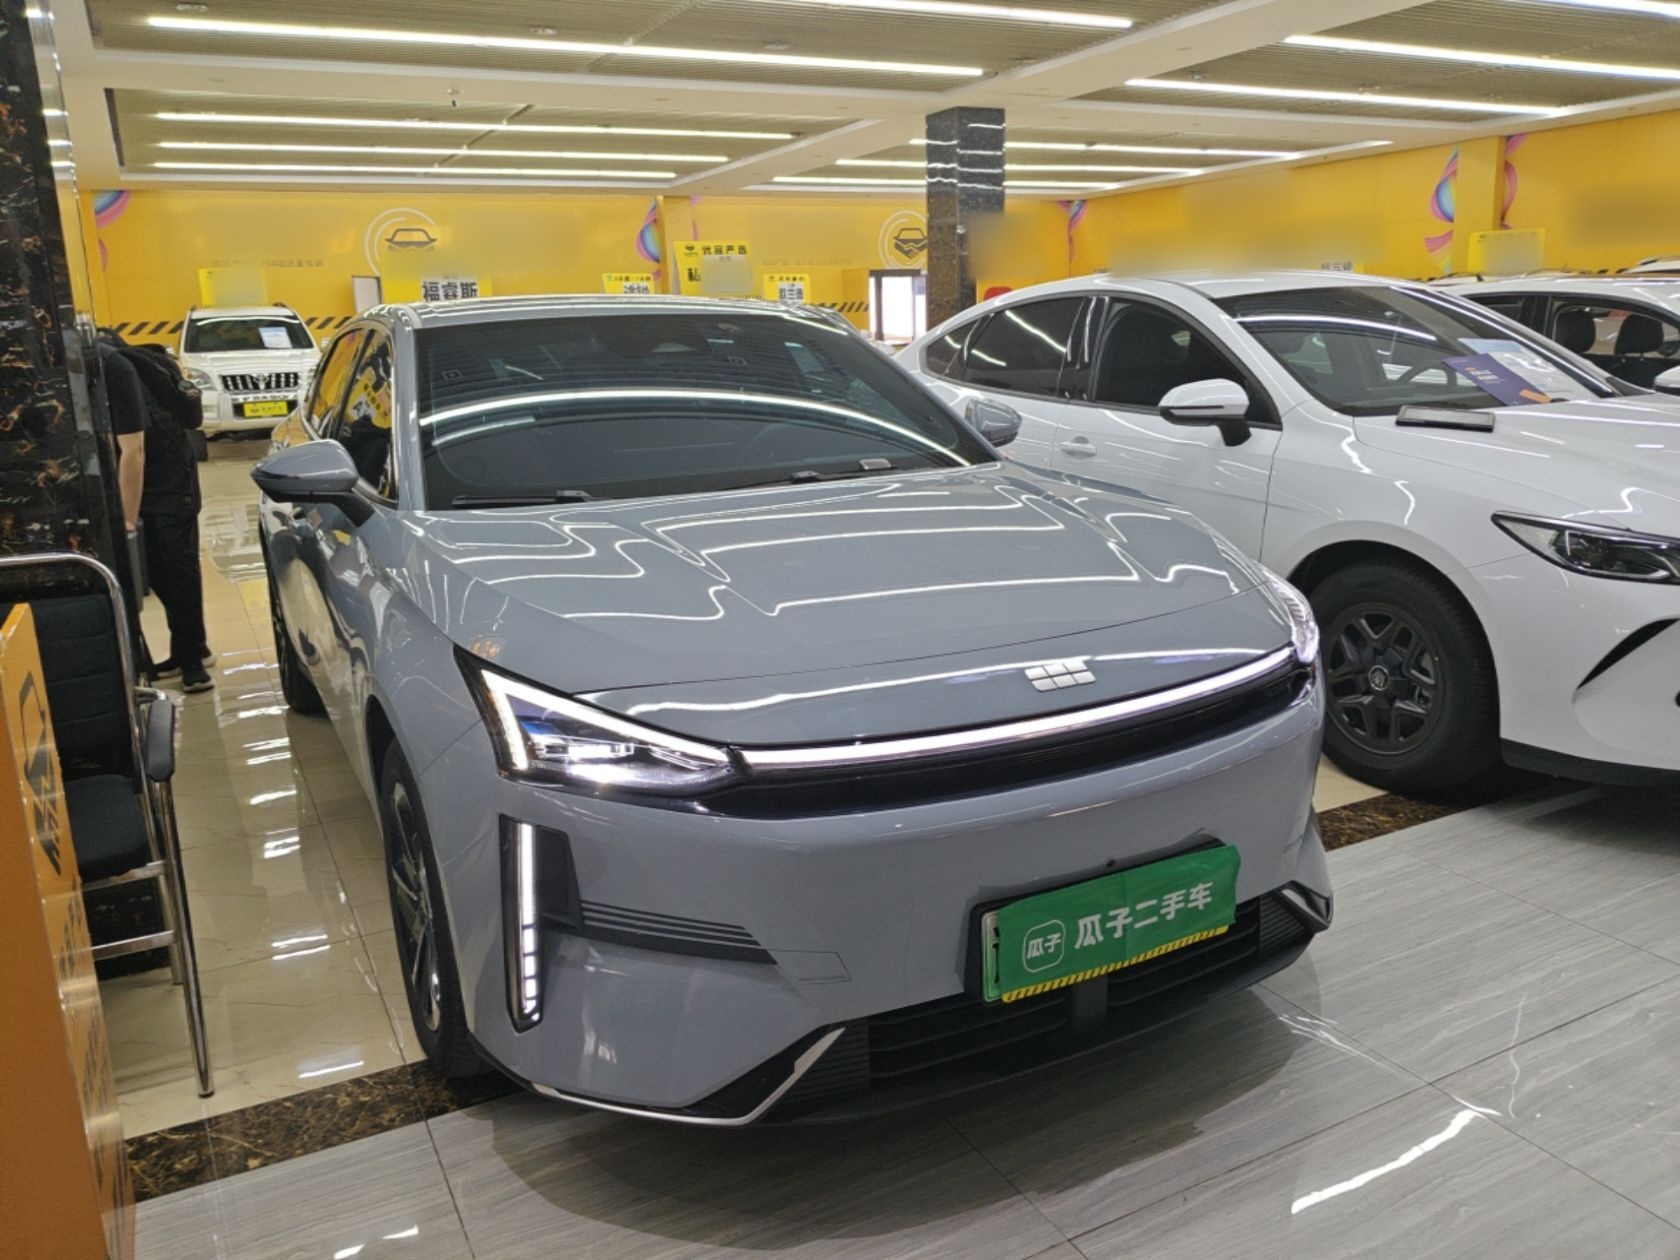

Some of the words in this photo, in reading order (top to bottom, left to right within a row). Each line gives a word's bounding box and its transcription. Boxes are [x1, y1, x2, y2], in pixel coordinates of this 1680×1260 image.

[422, 281, 478, 302] 福睿斯
[1074, 881, 1214, 949] 瓜子二手车
[1026, 931, 1062, 960] 瓜子
